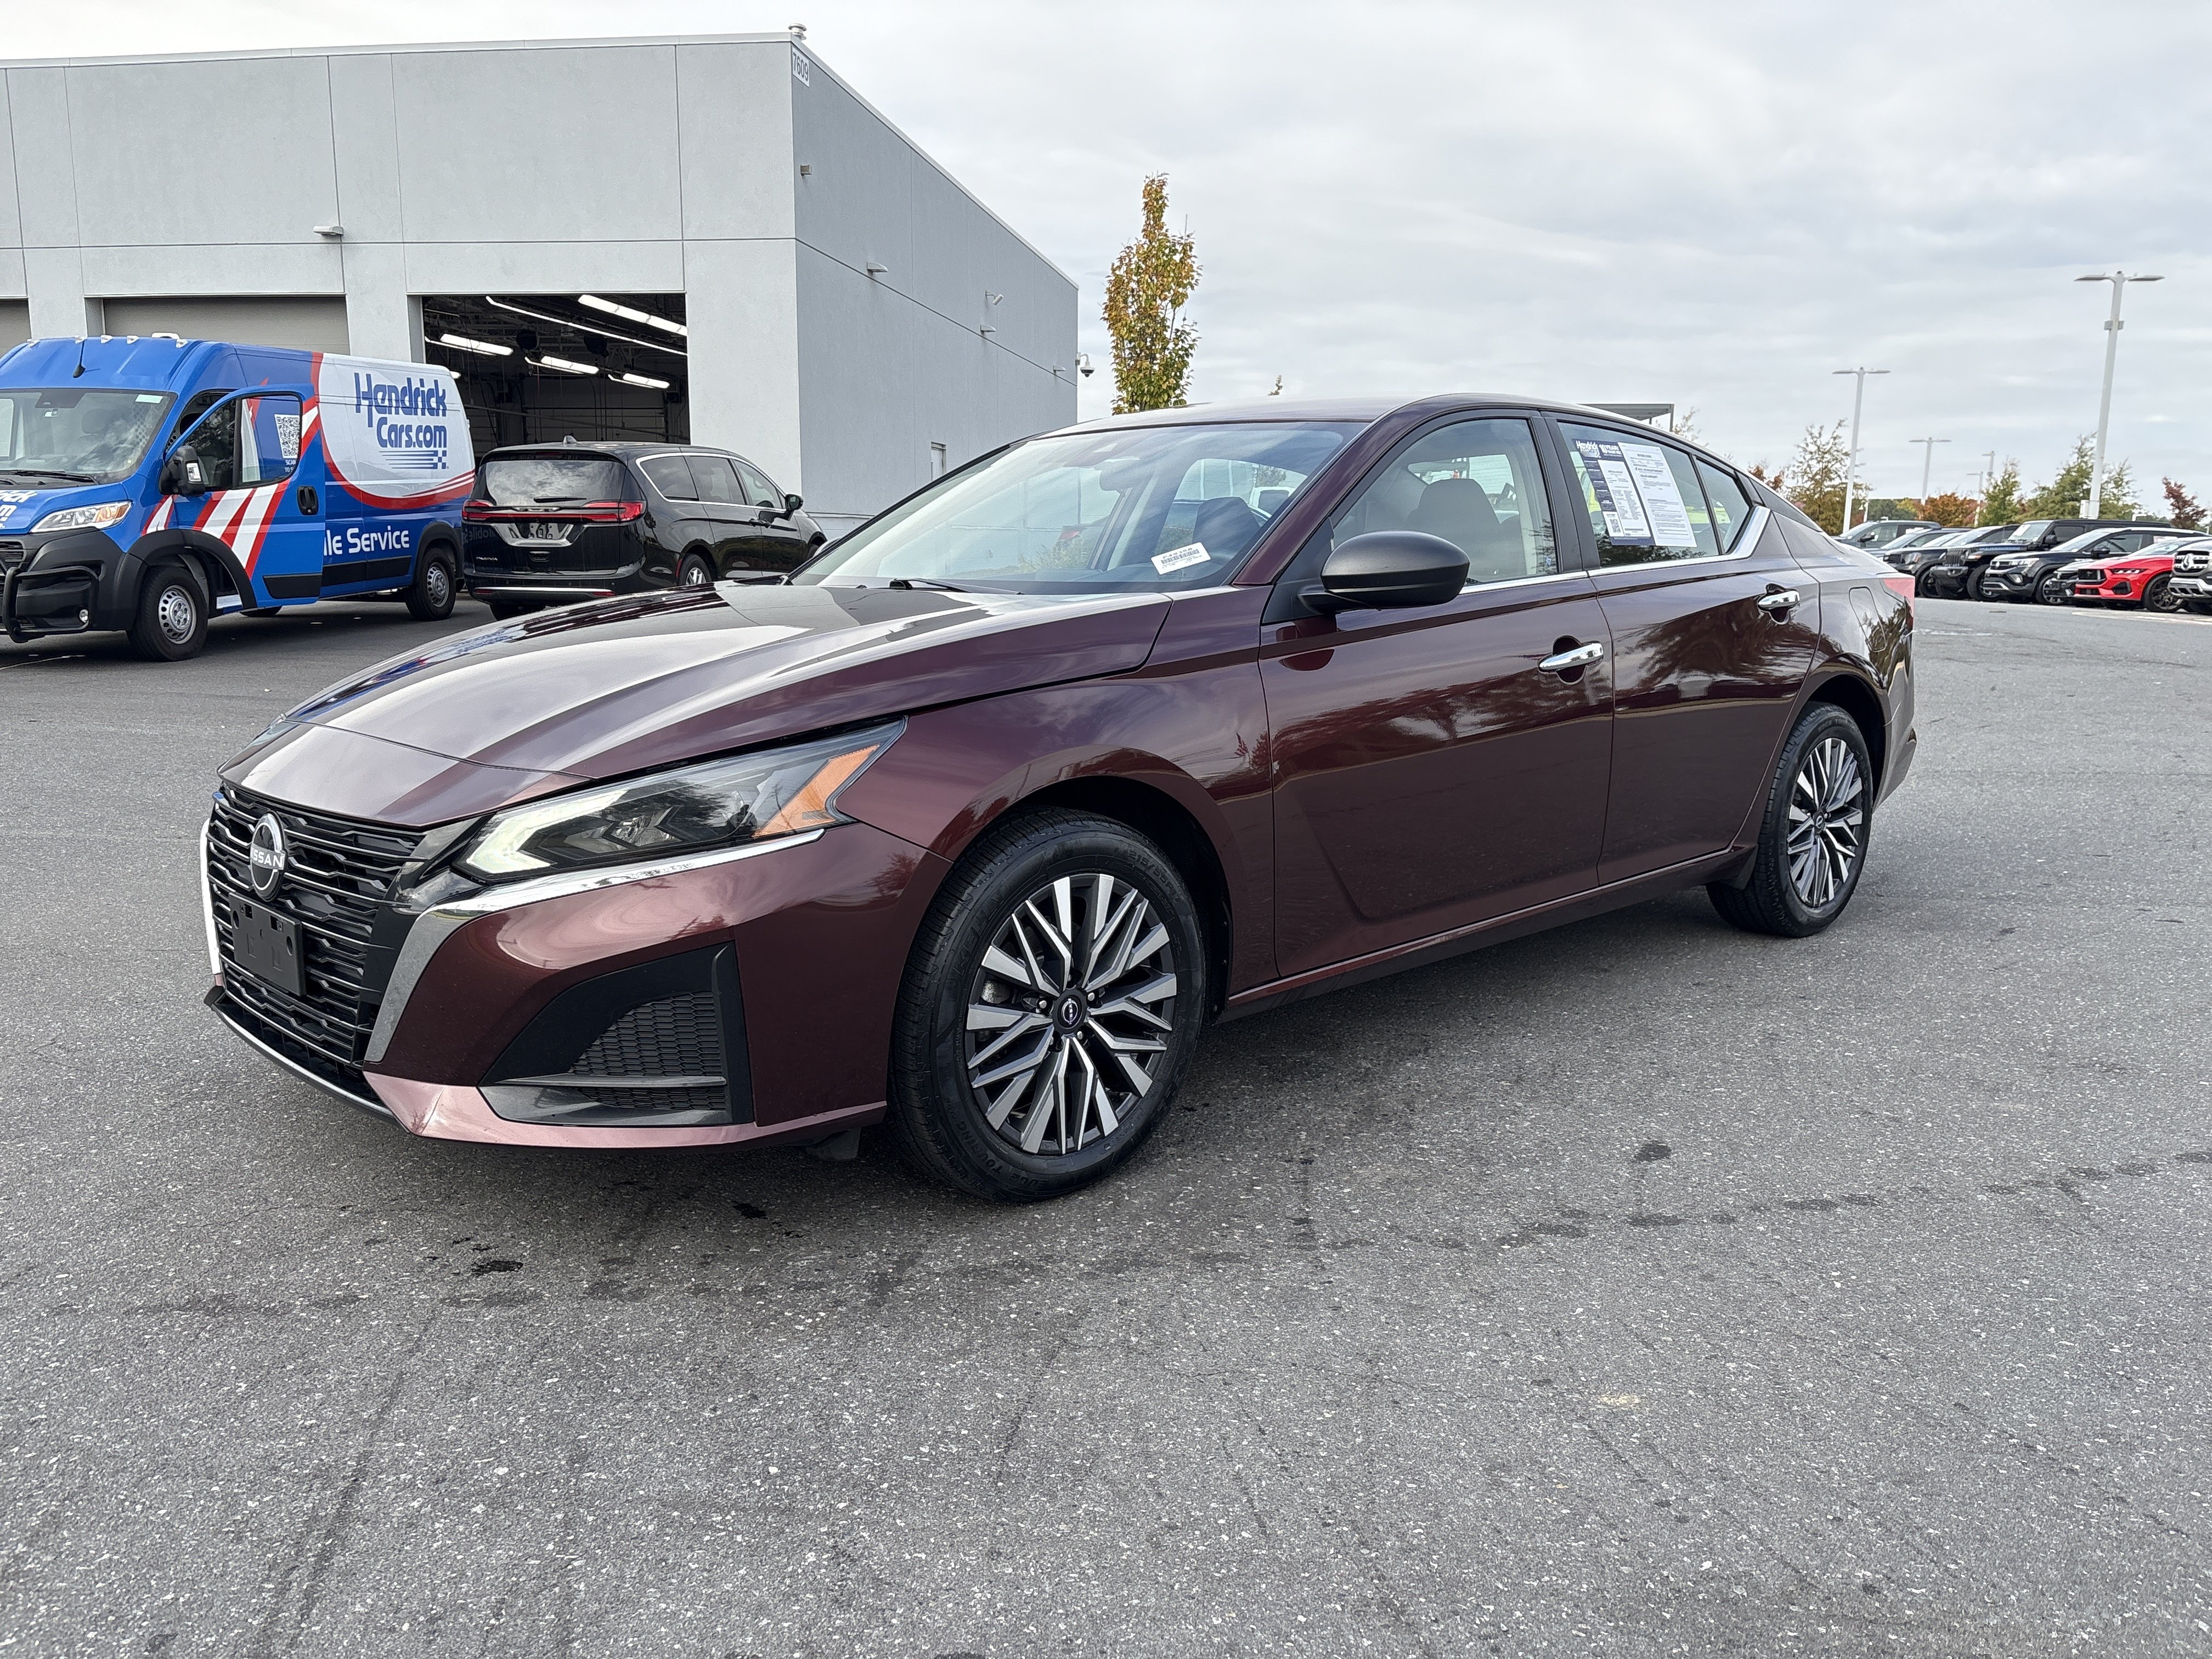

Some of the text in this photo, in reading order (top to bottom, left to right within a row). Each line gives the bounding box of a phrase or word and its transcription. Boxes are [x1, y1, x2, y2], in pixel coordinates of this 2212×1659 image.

[793, 52, 809, 82] 7609
[354, 373, 447, 427] Hendrick
[377, 417, 447, 448] Cars.com
[347, 525, 410, 554] Service
